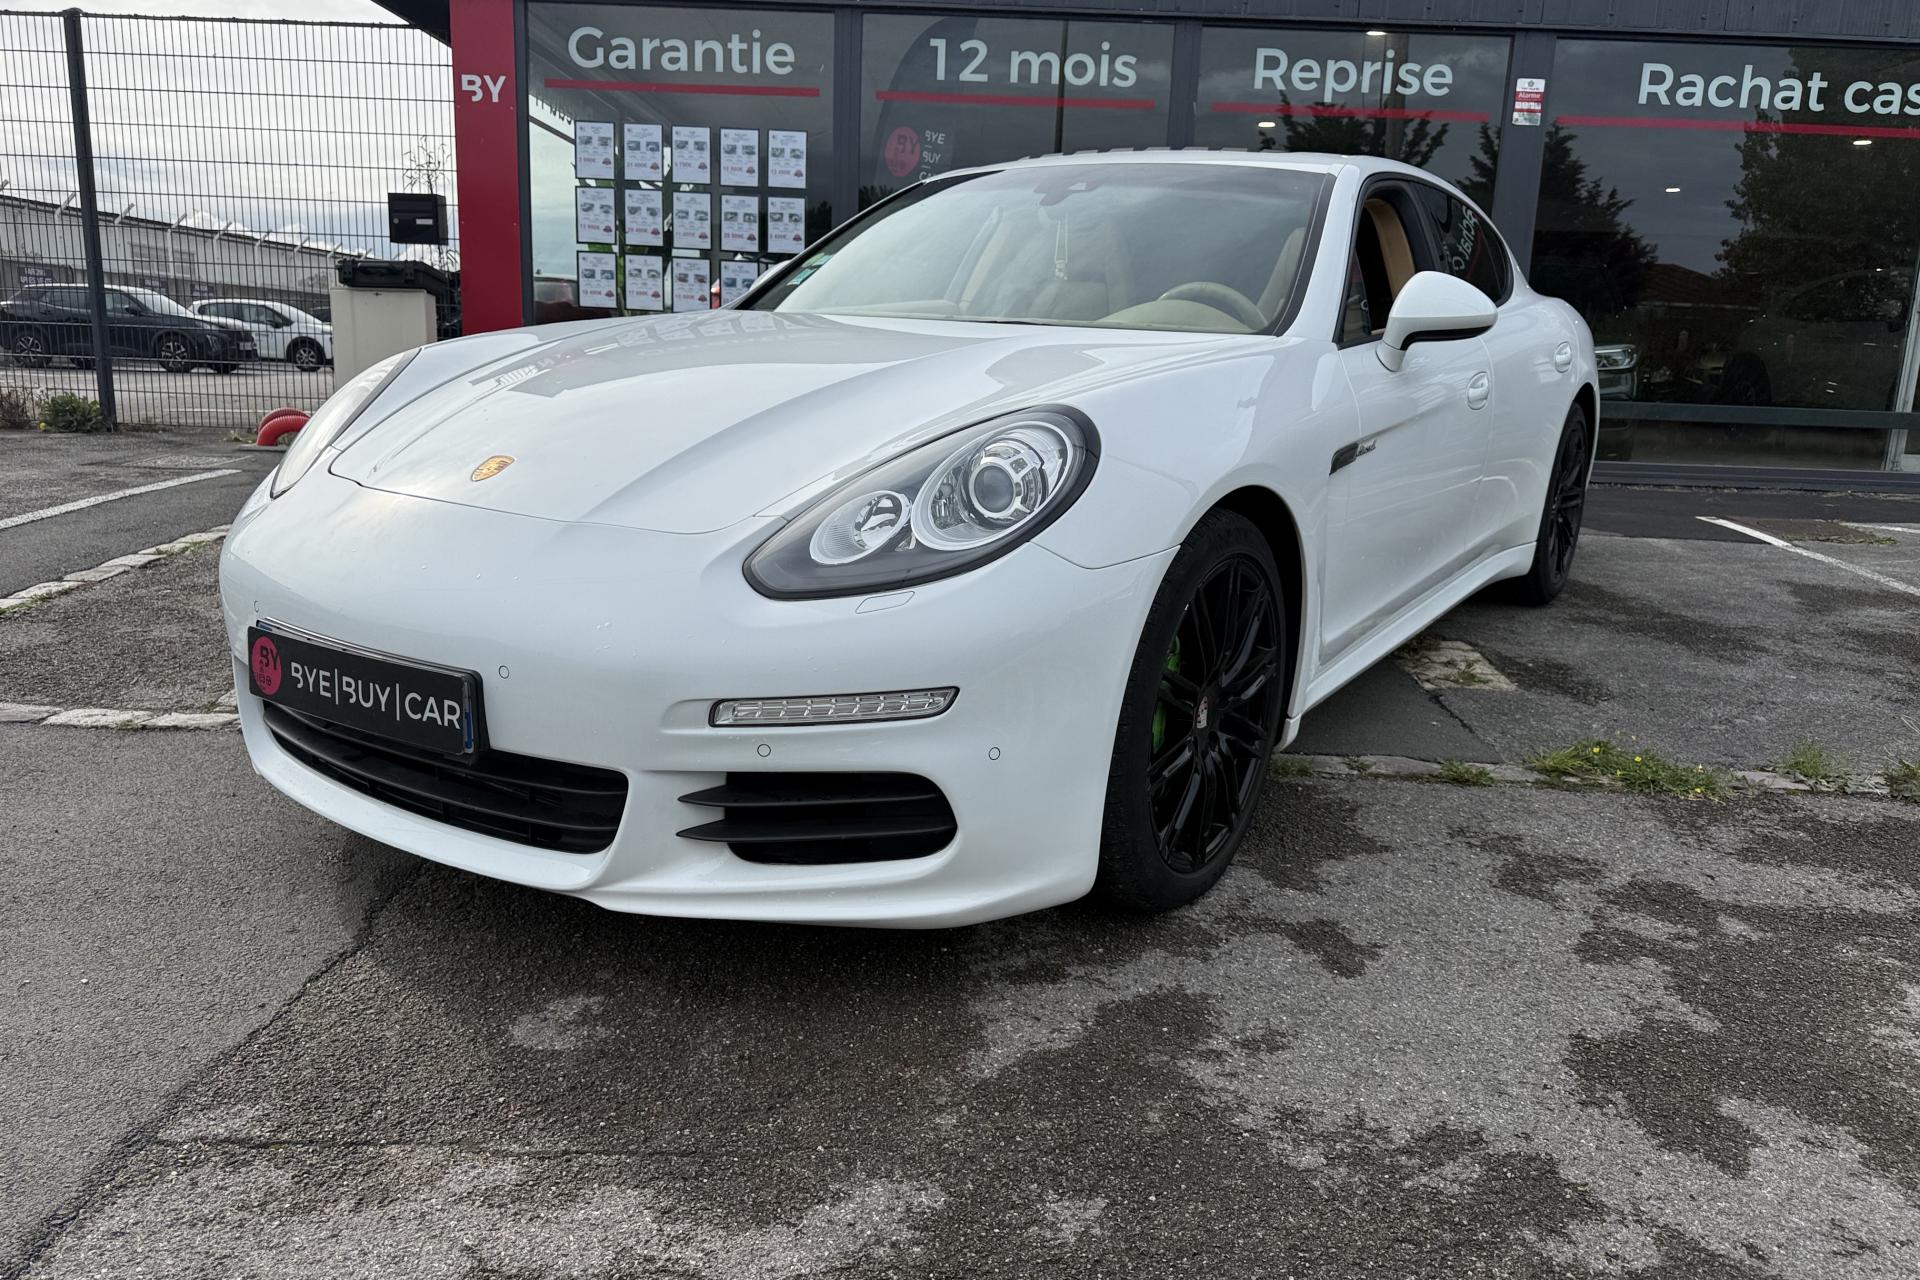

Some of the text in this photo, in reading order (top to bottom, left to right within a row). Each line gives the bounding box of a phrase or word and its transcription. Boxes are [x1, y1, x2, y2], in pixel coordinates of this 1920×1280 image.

[567, 26, 796, 75] Garantie
[929, 38, 1138, 88] 12 mois
[1253, 47, 1453, 103] Reprise
[461, 74, 507, 103] BY
[1637, 62, 1829, 112] Rachat
[922, 150, 941, 164] BUY
[925, 129, 946, 145] BYE
